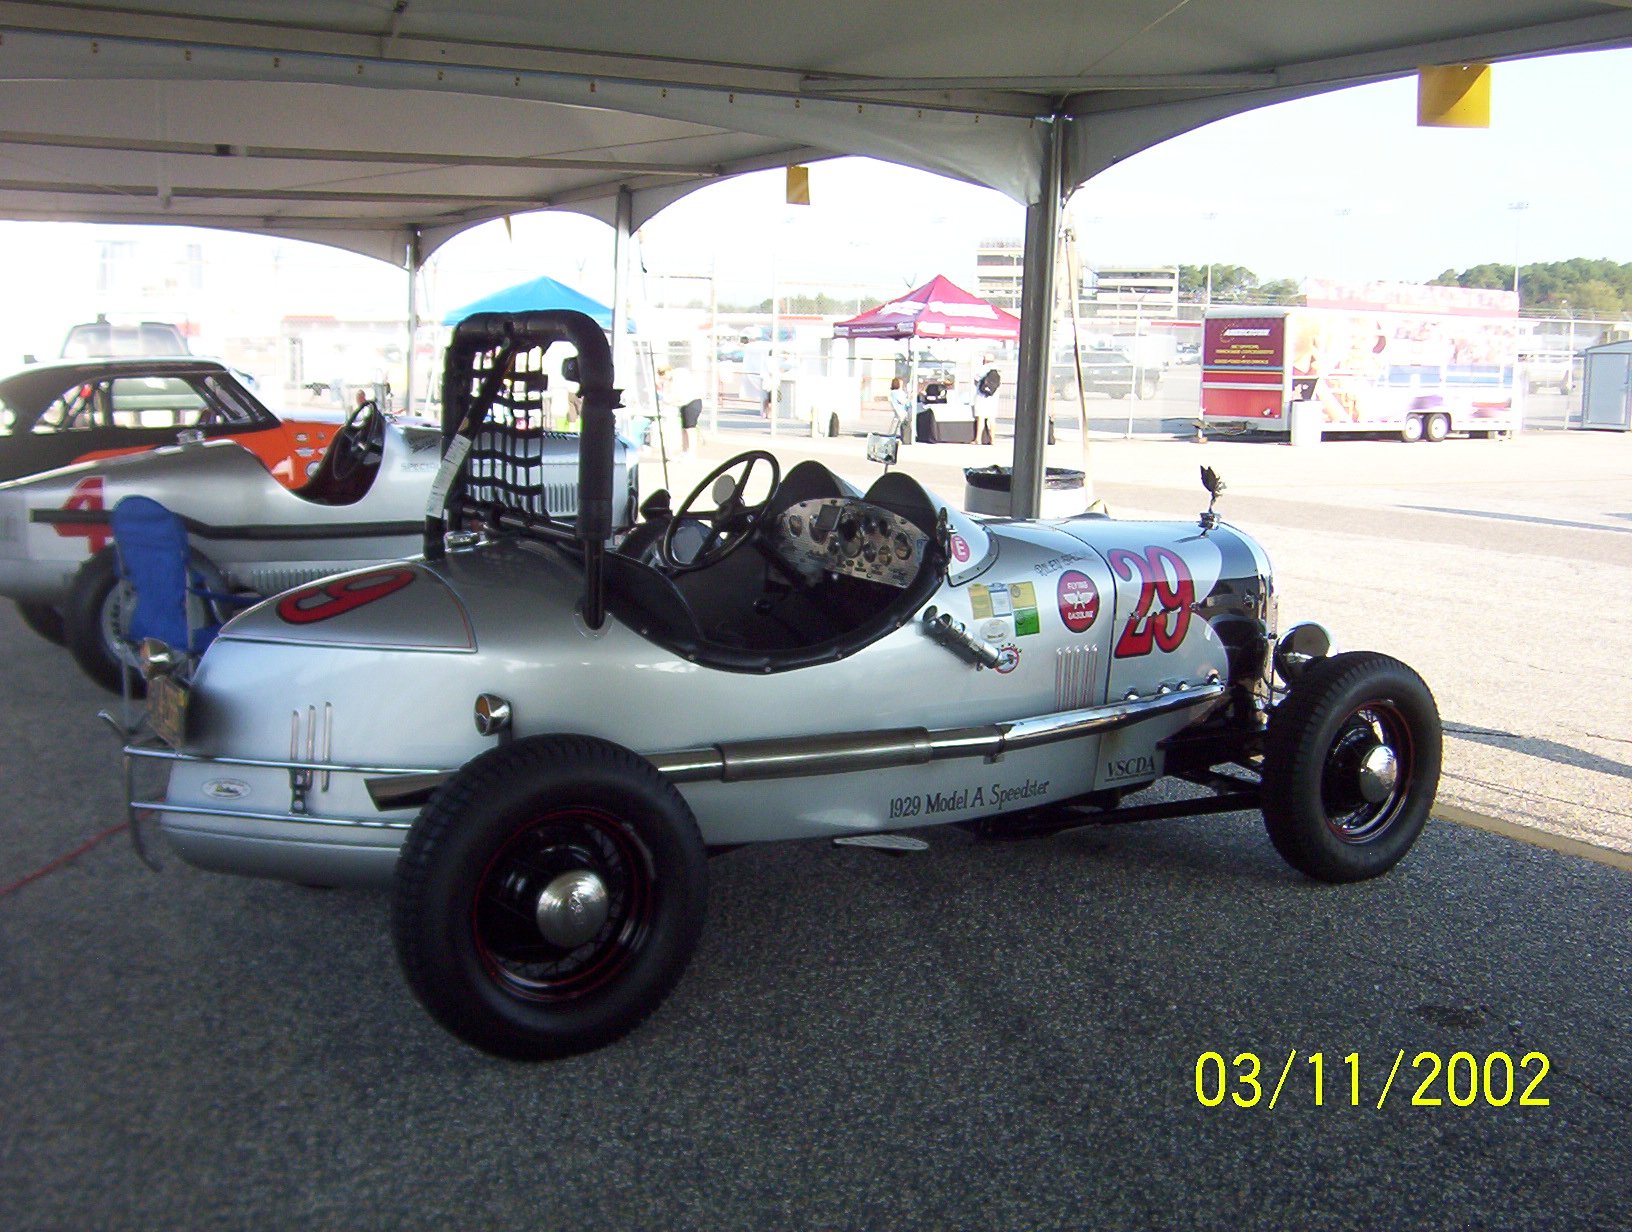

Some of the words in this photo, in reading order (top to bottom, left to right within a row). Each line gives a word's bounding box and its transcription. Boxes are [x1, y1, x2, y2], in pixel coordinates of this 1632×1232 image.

[53, 475, 114, 555] 4
[1107, 545, 1195, 659] 29
[1107, 755, 1156, 777] VSCDA
[889, 797, 921, 819] 1929
[925, 789, 968, 814] Model
[970, 787, 985, 808] A
[989, 779, 1050, 810] Speedster
